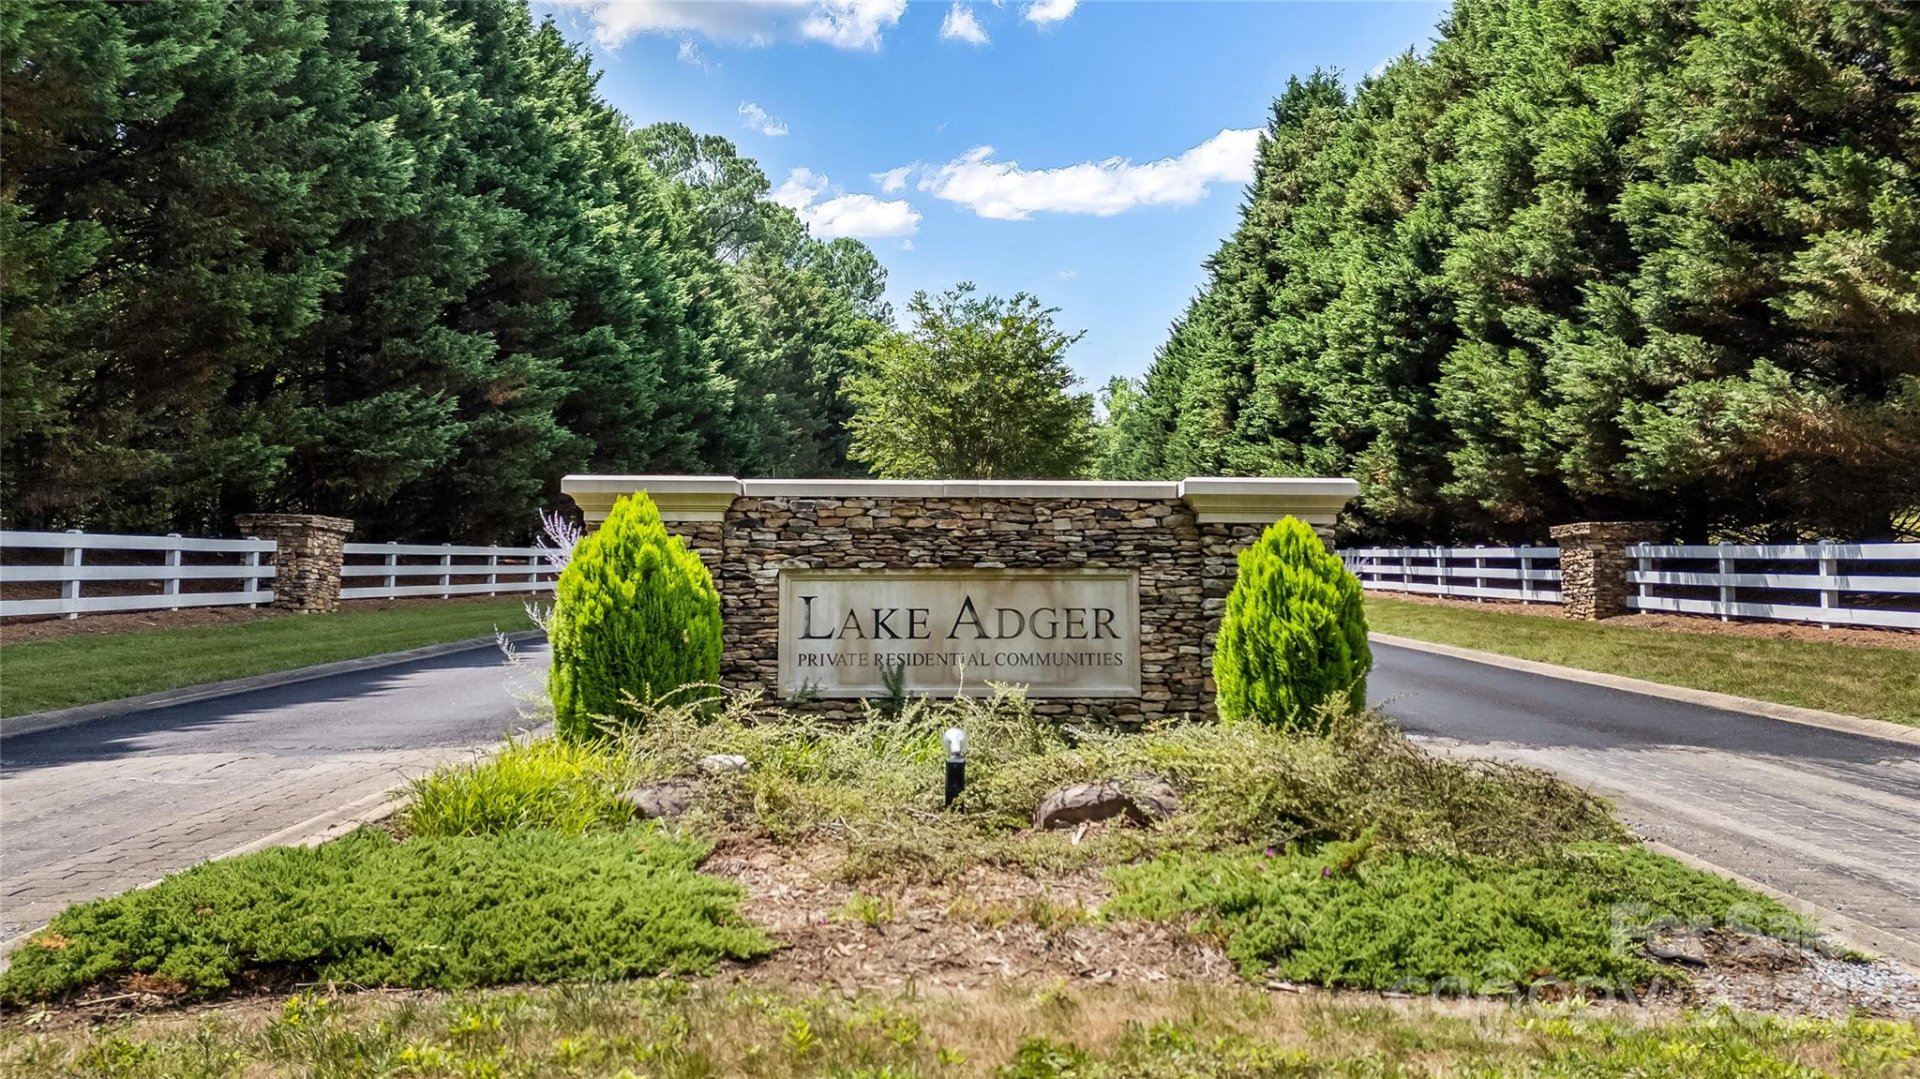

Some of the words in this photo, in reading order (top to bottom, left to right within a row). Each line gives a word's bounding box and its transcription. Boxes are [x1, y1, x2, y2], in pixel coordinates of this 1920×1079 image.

[797, 595, 932, 640] LAKE
[946, 594, 1122, 640] ADGER
[797, 652, 869, 667] PRIVATE
[873, 652, 991, 667] RESIDENTIAL
[994, 652, 1123, 667] COMMUNITIES
